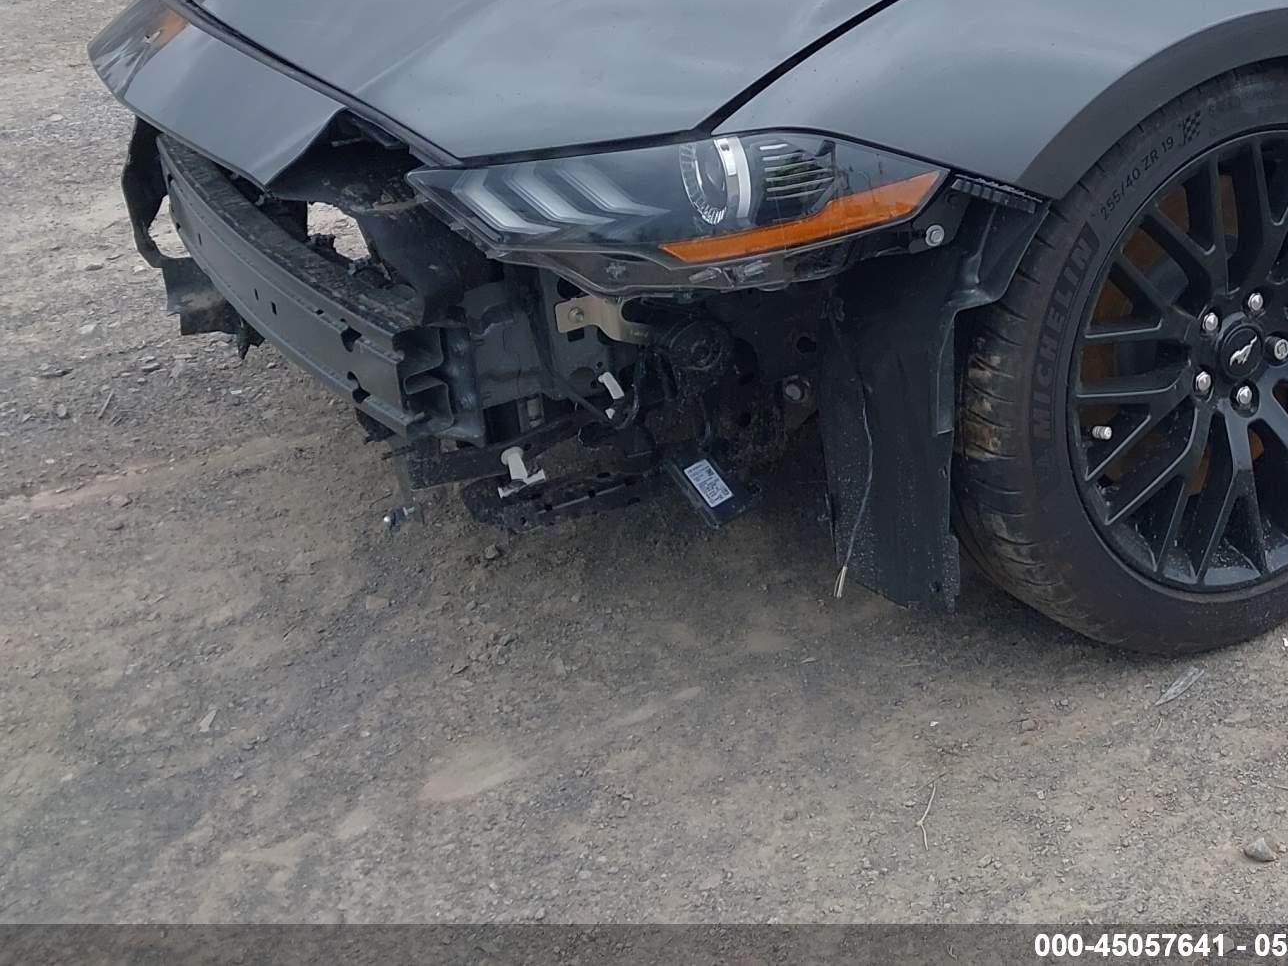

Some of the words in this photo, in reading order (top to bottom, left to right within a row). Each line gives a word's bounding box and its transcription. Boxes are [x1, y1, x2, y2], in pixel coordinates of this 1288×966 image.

[1100, 168, 1141, 221] 255/40
[1142, 149, 1160, 171] ZR
[1161, 136, 1175, 153] 19
